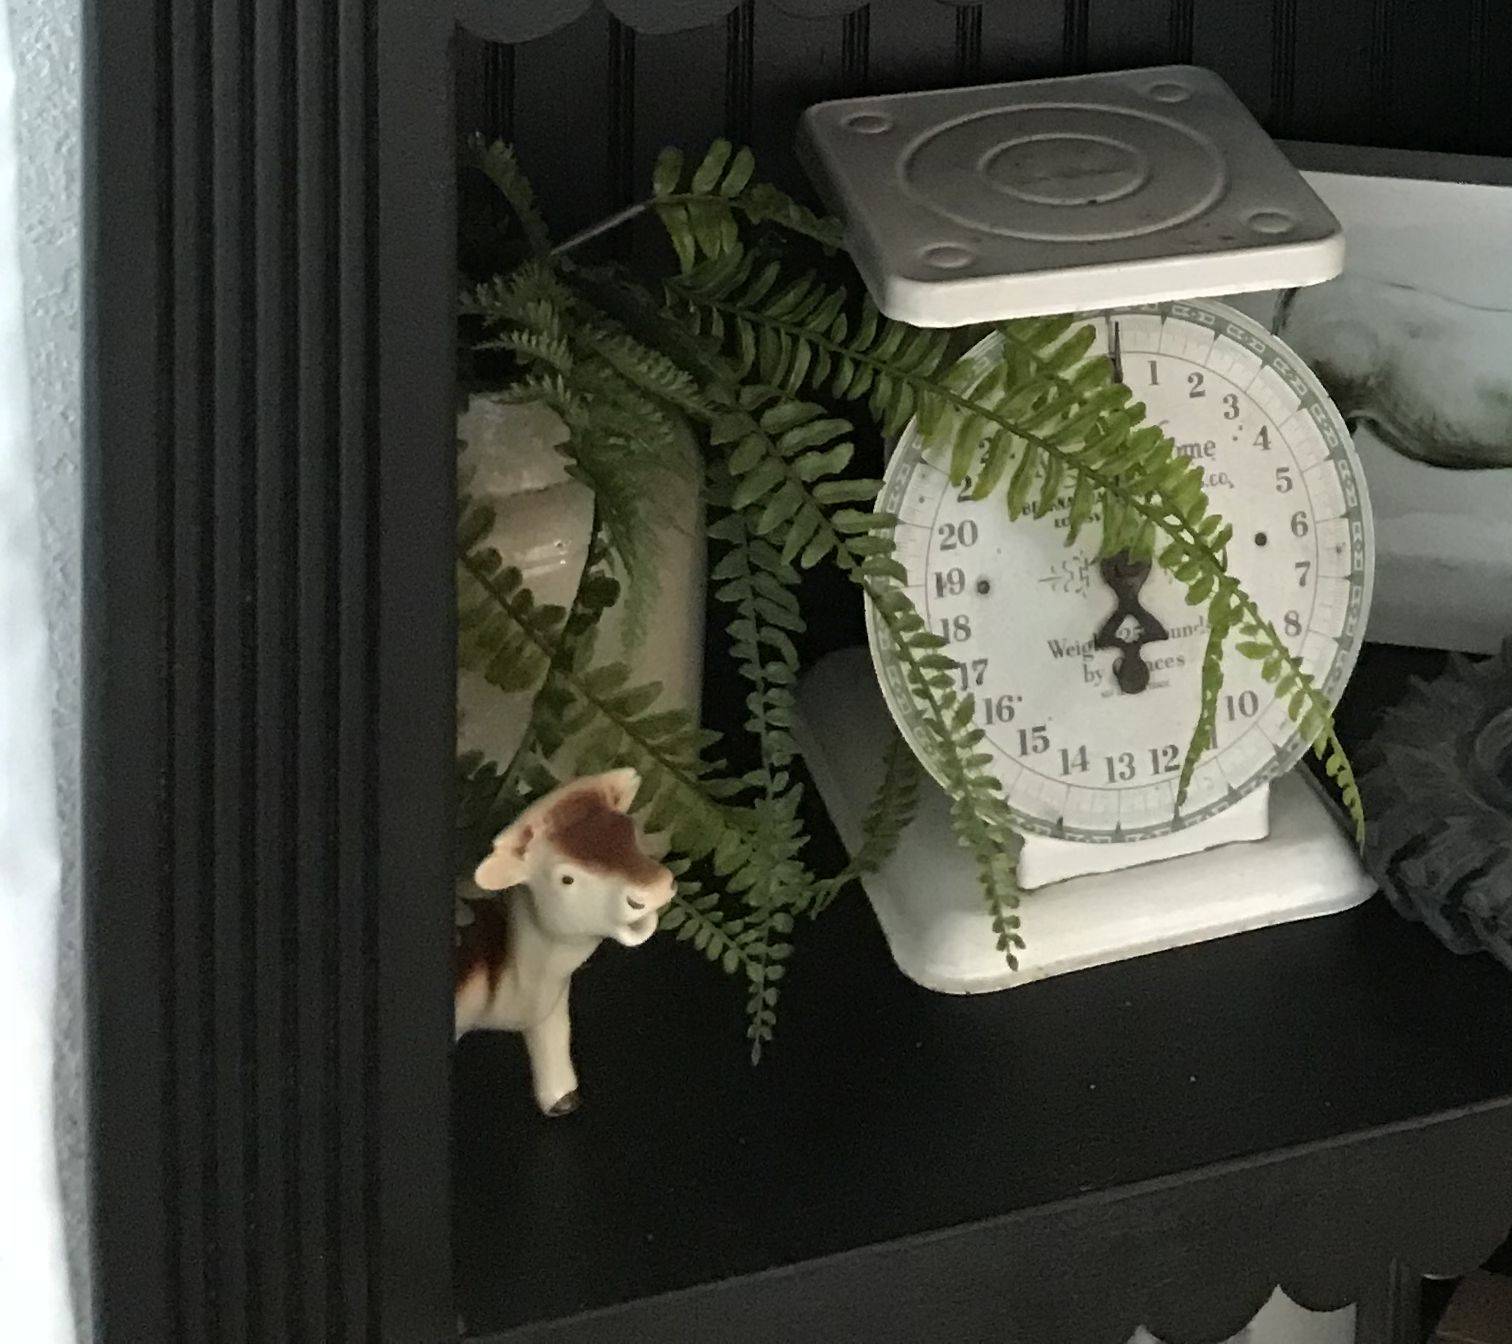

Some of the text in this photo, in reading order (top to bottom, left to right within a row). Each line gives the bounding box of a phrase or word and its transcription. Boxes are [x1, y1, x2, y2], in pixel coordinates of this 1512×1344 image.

[1148, 360, 1158, 385] 1
[1187, 372, 1206, 398] 2
[1222, 393, 1240, 420] 3
[1252, 425, 1272, 451] 4
[1275, 467, 1293, 493] 5
[937, 519, 979, 551] 20
[1291, 511, 1309, 537] 6
[934, 567, 966, 599] 19
[1294, 561, 1311, 587] 7
[940, 614, 972, 644] 18
[1283, 610, 1303, 638] 8
[957, 657, 990, 691] 17
[982, 693, 1015, 725] 16
[1224, 689, 1260, 722] 10
[1016, 724, 1051, 758] 15
[1059, 744, 1091, 778] 14
[1106, 752, 1137, 784] 13
[1149, 743, 1181, 776] 12
